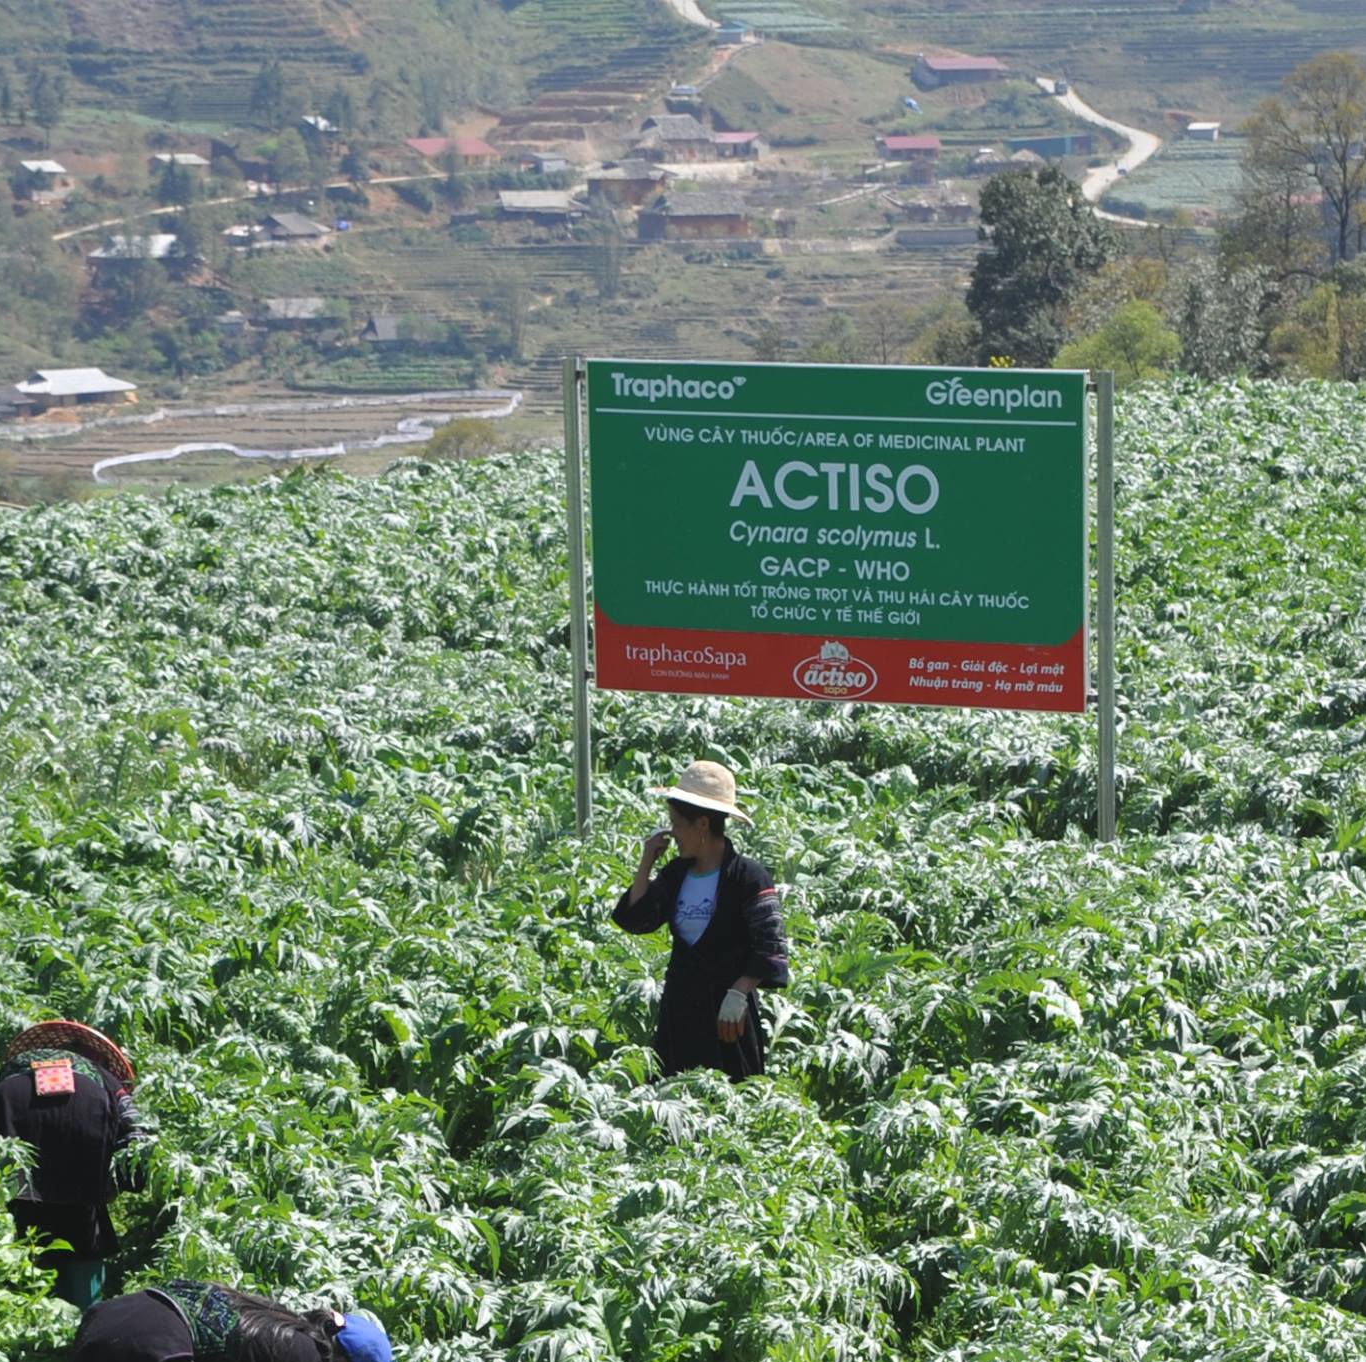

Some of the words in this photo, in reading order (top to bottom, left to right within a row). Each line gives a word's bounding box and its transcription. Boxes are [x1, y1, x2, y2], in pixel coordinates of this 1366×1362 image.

[611, 373, 734, 402] Traphaco
[926, 377, 1062, 413] Greenplan
[645, 424, 694, 442] VÙNG
[699, 426, 735, 443] CÂY
[740, 426, 849, 447] THUỐC/AREA
[853, 433, 873, 447] OF
[879, 434, 971, 450] MEDICINAL
[976, 437, 1025, 452] PLANT
[730, 460, 939, 514] ACTISO
[730, 520, 808, 546] Cynara
[817, 525, 917, 550] scolymus
[926, 528, 940, 549] L.
[760, 556, 830, 577] GACP
[854, 560, 910, 581] WHO
[645, 580, 683, 595] THỰC
[688, 580, 729, 596] HÀNH
[734, 580, 758, 597] TỐT
[815, 588, 848, 603] TRỌT
[852, 587, 873, 602] VÀ
[877, 590, 904, 604] THU
[910, 589, 934, 605] HÁI
[939, 591, 973, 606] CÂY
[978, 592, 1029, 609] THUỐC
[751, 600, 768, 618] TỔ
[772, 604, 816, 620] CHỨC
[822, 608, 831, 620] Y
[836, 605, 852, 622] TẾ
[857, 607, 883, 623] THẾ
[888, 609, 920, 625] GIỚI
[626, 643, 746, 670] traphacoSapa
[927, 661, 949, 672] gan
[988, 661, 1008, 674] độc
[1020, 663, 1037, 675] Lợi
[1041, 664, 1064, 677] mật
[804, 664, 867, 687] actiso
[910, 676, 948, 689] Nhuận
[952, 678, 983, 692] tràng
[995, 680, 1011, 693] Hạ
[1015, 681, 1035, 691] mỡ
[1037, 682, 1063, 692] máu
